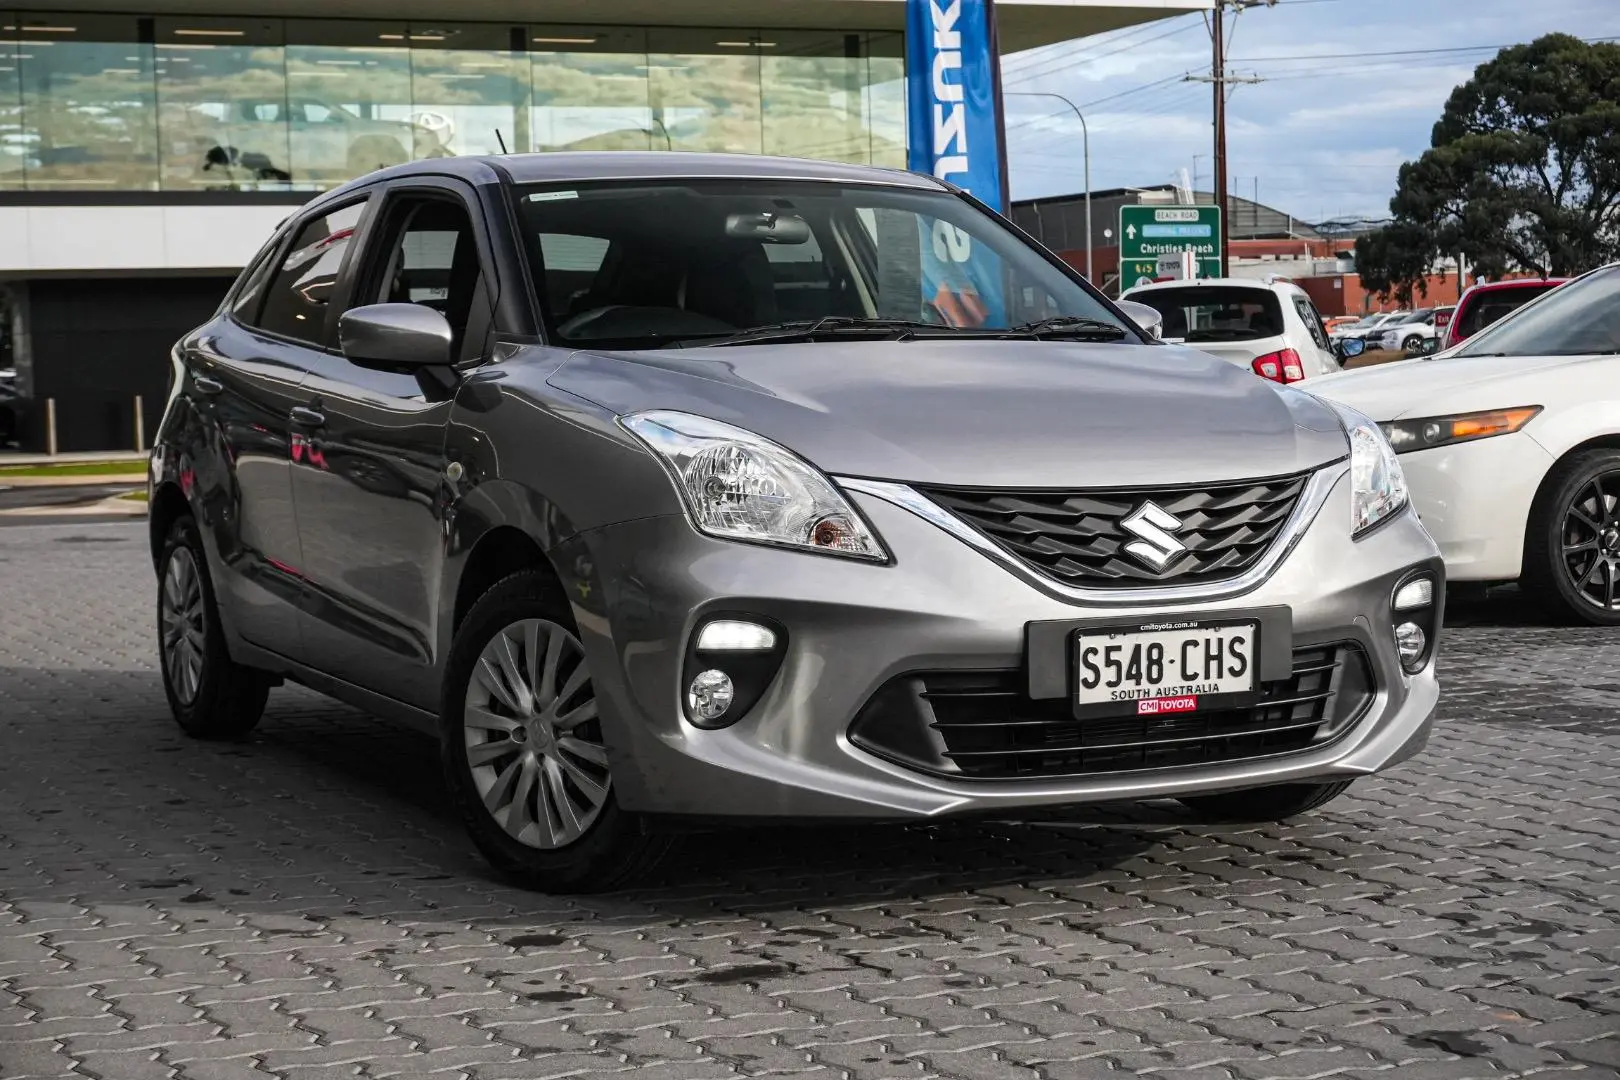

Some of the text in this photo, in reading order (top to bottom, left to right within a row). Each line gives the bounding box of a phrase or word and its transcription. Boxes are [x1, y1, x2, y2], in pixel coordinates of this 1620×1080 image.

[1157, 211, 1197, 219] BEACH ROAD
[1140, 243, 1182, 254] Christies
[1140, 620, 1198, 631] cmitoyota.com.au
[1111, 683, 1219, 700] SOUTH AUSTRALIA
[1159, 698, 1195, 710] TOYOTA
